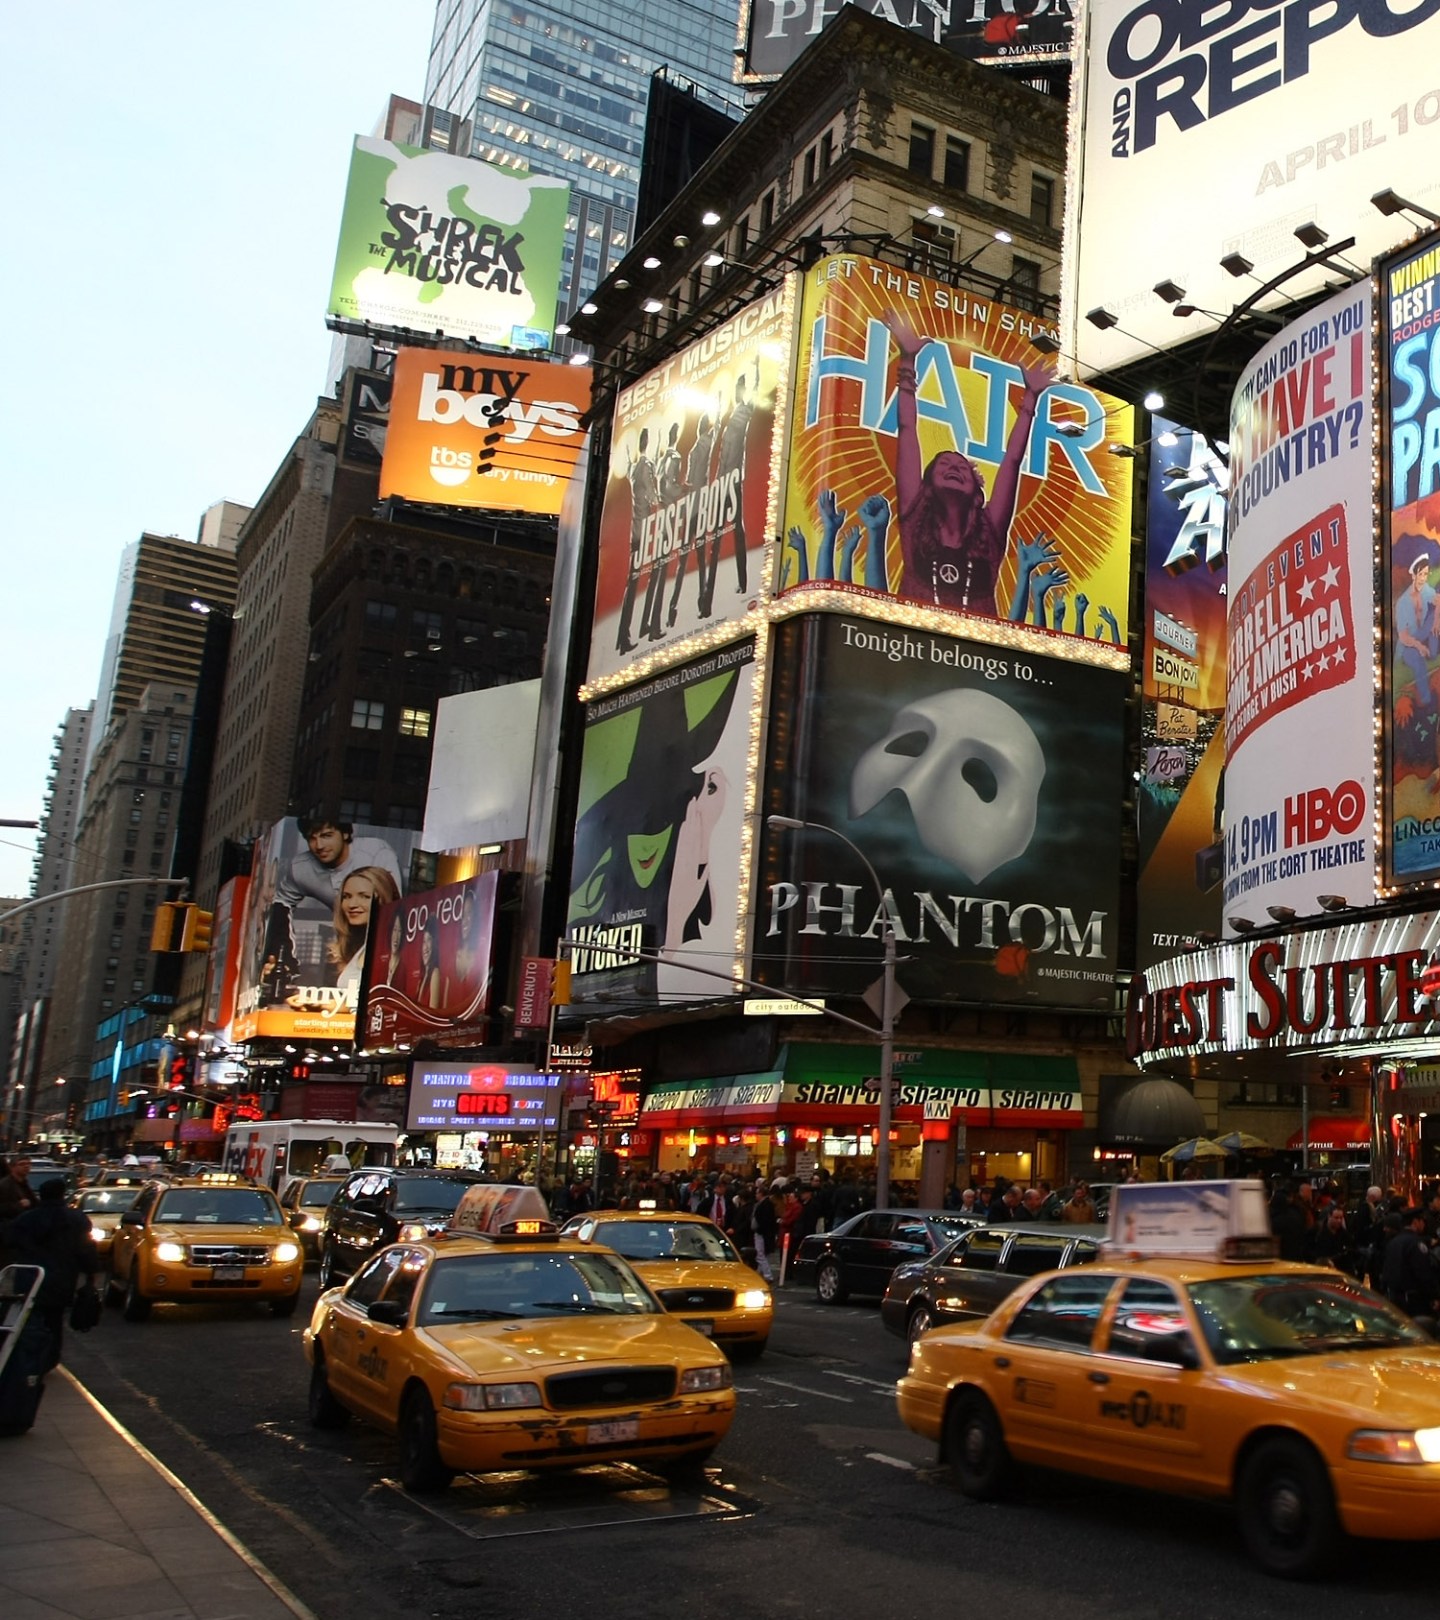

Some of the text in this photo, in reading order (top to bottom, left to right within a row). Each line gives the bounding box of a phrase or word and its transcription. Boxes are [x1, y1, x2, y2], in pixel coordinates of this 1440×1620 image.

[1008, 42, 1061, 56] MAJESTIC
[1111, 86, 1131, 158] AND
[1258, 119, 1387, 195] APRIL
[379, 198, 526, 273] SHREK
[368, 243, 523, 296] THE MUSICAL
[815, 258, 988, 324] LET THE SUN
[1391, 280, 1435, 330] BEST
[617, 291, 785, 417] BEST MUSICAL
[623, 319, 781, 427] 2006 Award Winner
[1256, 300, 1364, 394] CAN DO FOR YOU
[417, 372, 581, 444] boys
[438, 363, 531, 417] my
[804, 316, 1110, 498] HAIR
[1251, 346, 1336, 463] HAVE
[1350, 330, 1364, 400] I
[430, 445, 473, 468] tbs
[513, 467, 559, 486] funny.
[1242, 400, 1364, 518] COUNTRY?
[633, 490, 697, 570] JERSEY
[695, 468, 740, 539] BOYS
[1266, 518, 1340, 591] EVENT
[840, 621, 1054, 687] Tonight belongs to...
[1155, 620, 1195, 651] JOURNEY
[1253, 598, 1346, 693] AMERICA
[587, 644, 753, 721] SO MUCH HAPPENED BEFORE DOROTHY DROPPED
[1155, 655, 1198, 685] BON JOVI
[1159, 721, 1196, 736] Benatar
[1169, 707, 1184, 723] Pat
[1237, 698, 1260, 735] GEORGE
[1261, 686, 1269, 710] W
[1270, 667, 1297, 703] BUSH
[1148, 750, 1185, 776] Poison
[1284, 779, 1366, 850] HBO
[1241, 838, 1366, 895] FROM THE CORT THEATRE
[406, 885, 467, 943] go red
[764, 880, 1108, 960] PHANTOM
[1152, 933, 1180, 947] TEXT
[571, 922, 643, 975] WICKED
[1044, 967, 1116, 984] MAJESTIC THEATRE
[519, 961, 538, 1025] BENVENUTO
[293, 1018, 355, 1029] starting march
[423, 1074, 471, 1087] PHANTOM
[457, 1094, 508, 1113] GIFTS
[647, 1091, 681, 1112] sbarro
[688, 1088, 724, 1109] sbarro
[734, 1082, 774, 1106] sbarro
[794, 1080, 1074, 1111] sbarro sbarro sbarro
[224, 1132, 267, 1178] FedEx
[515, 1221, 540, 1234] 3N21
